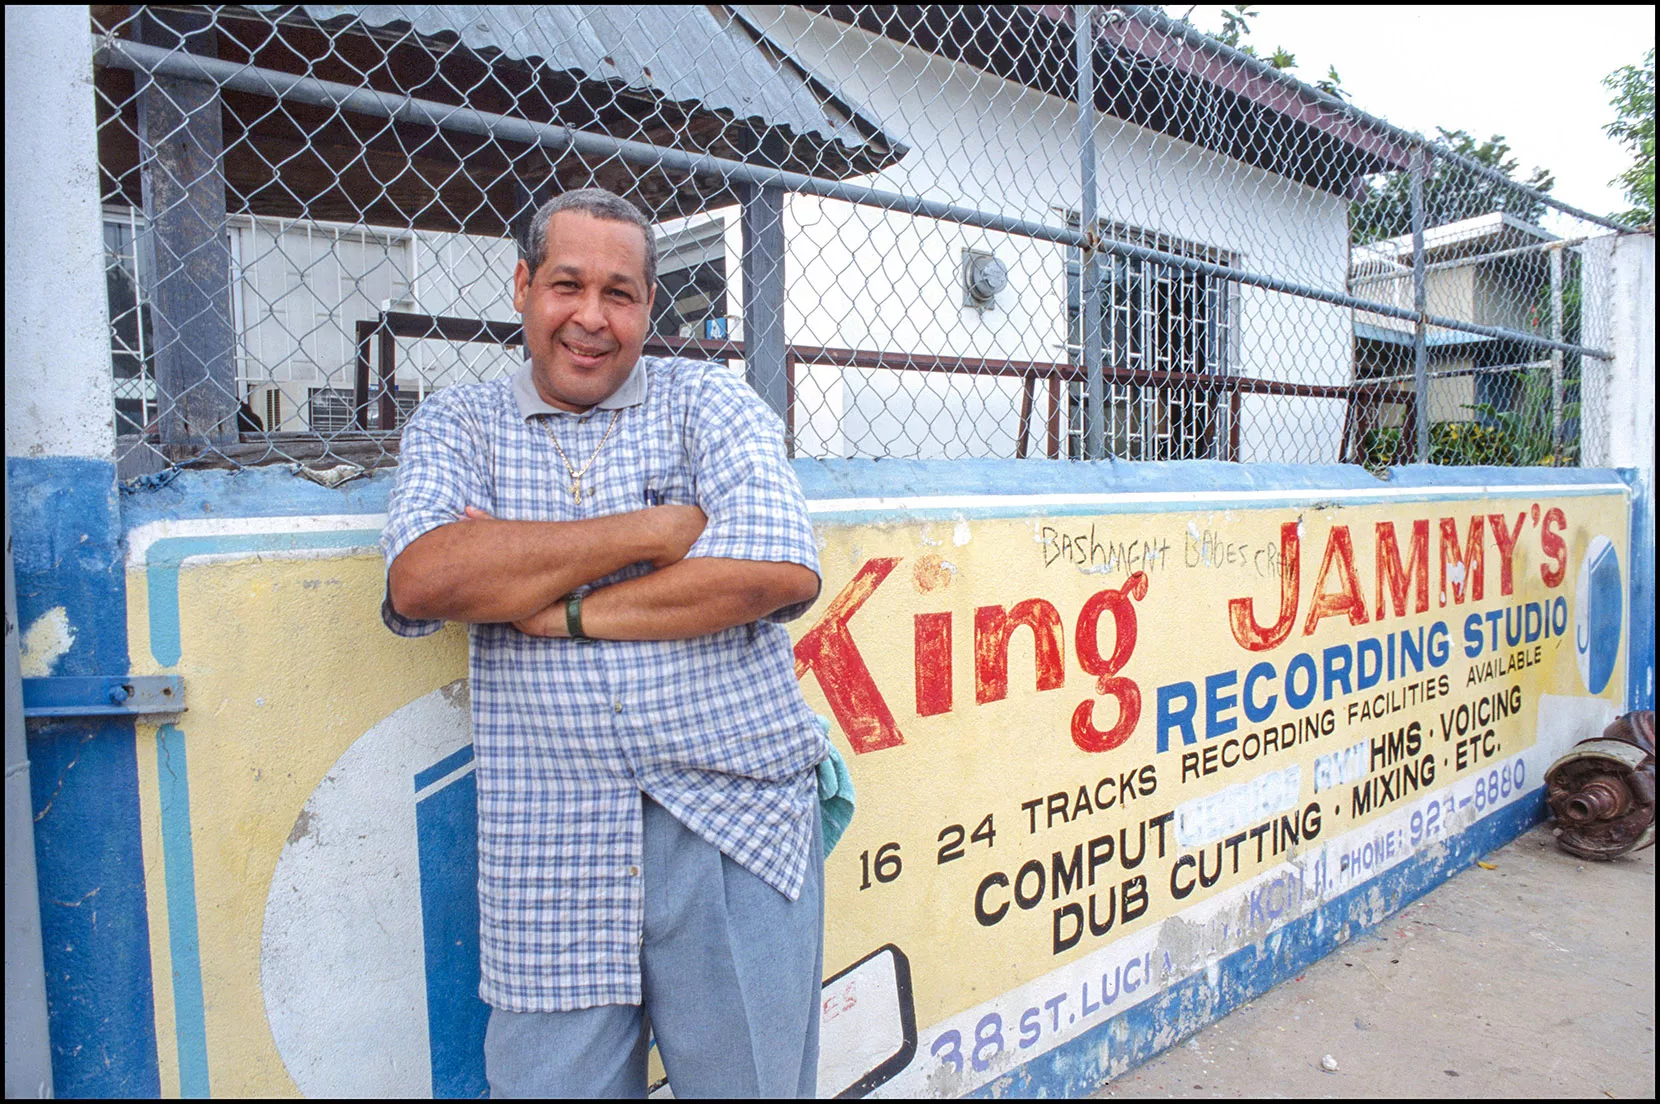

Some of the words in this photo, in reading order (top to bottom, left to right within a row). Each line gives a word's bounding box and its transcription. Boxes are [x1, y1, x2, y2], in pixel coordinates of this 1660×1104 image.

[794, 556, 1149, 755] King
[1228, 503, 1568, 652] JAMMY'S
[1157, 620, 1449, 754] RECORDING
[1463, 596, 1568, 658] STUDIO
[1441, 685, 1522, 742] VOICING
[859, 842, 903, 892] 16
[937, 813, 997, 865] 24
[1021, 764, 1158, 834] TRACKS
[1182, 709, 1336, 784] RECORDING
[1348, 674, 1450, 725] FACILITIES
[1466, 646, 1542, 688] AVAILABLE
[1053, 874, 1150, 955] DUB
[1170, 801, 1322, 900] CUTTING
[1352, 754, 1435, 819] MIXING
[1456, 729, 1502, 772] ETC.
